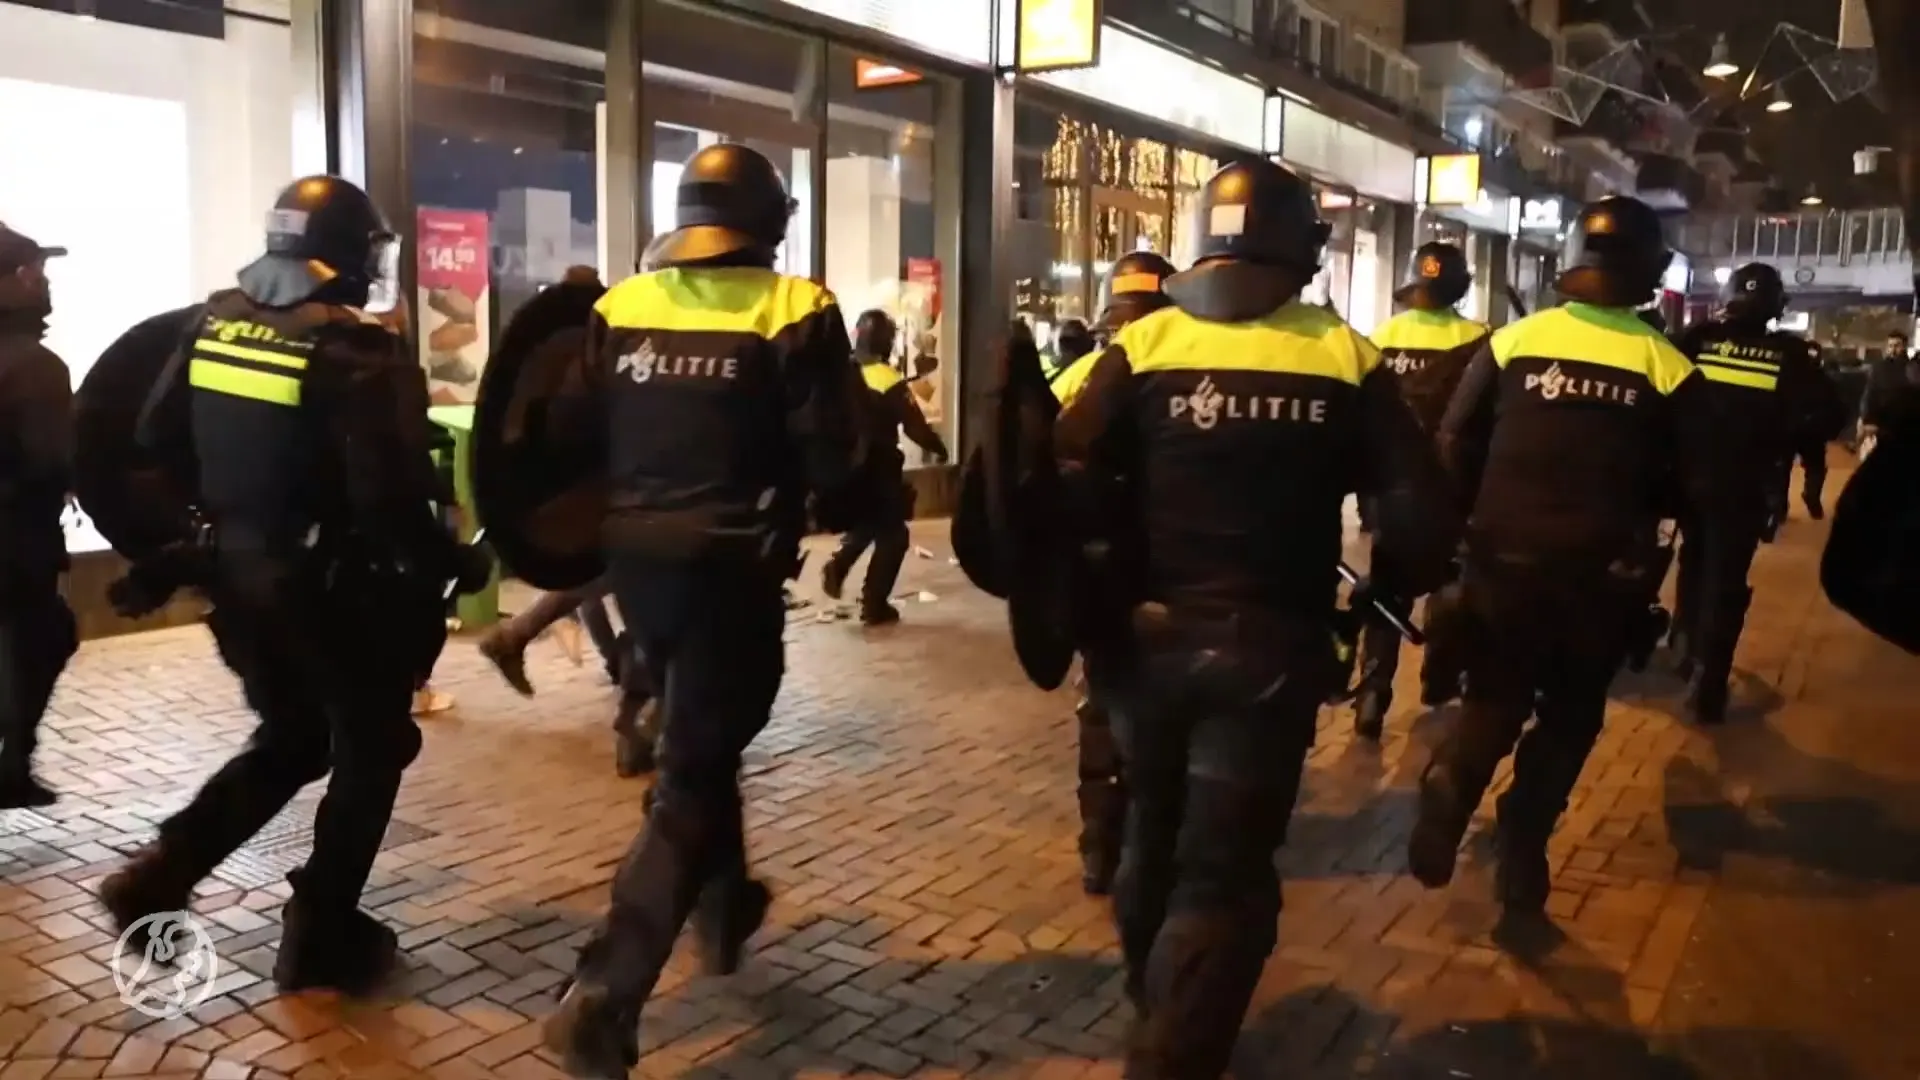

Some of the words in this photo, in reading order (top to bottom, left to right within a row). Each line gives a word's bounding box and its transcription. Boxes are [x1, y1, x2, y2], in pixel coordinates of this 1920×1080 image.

[615, 336, 739, 384] POLITIE
[1524, 360, 1638, 406] POLITIE
[1168, 375, 1328, 429] POLITIE
